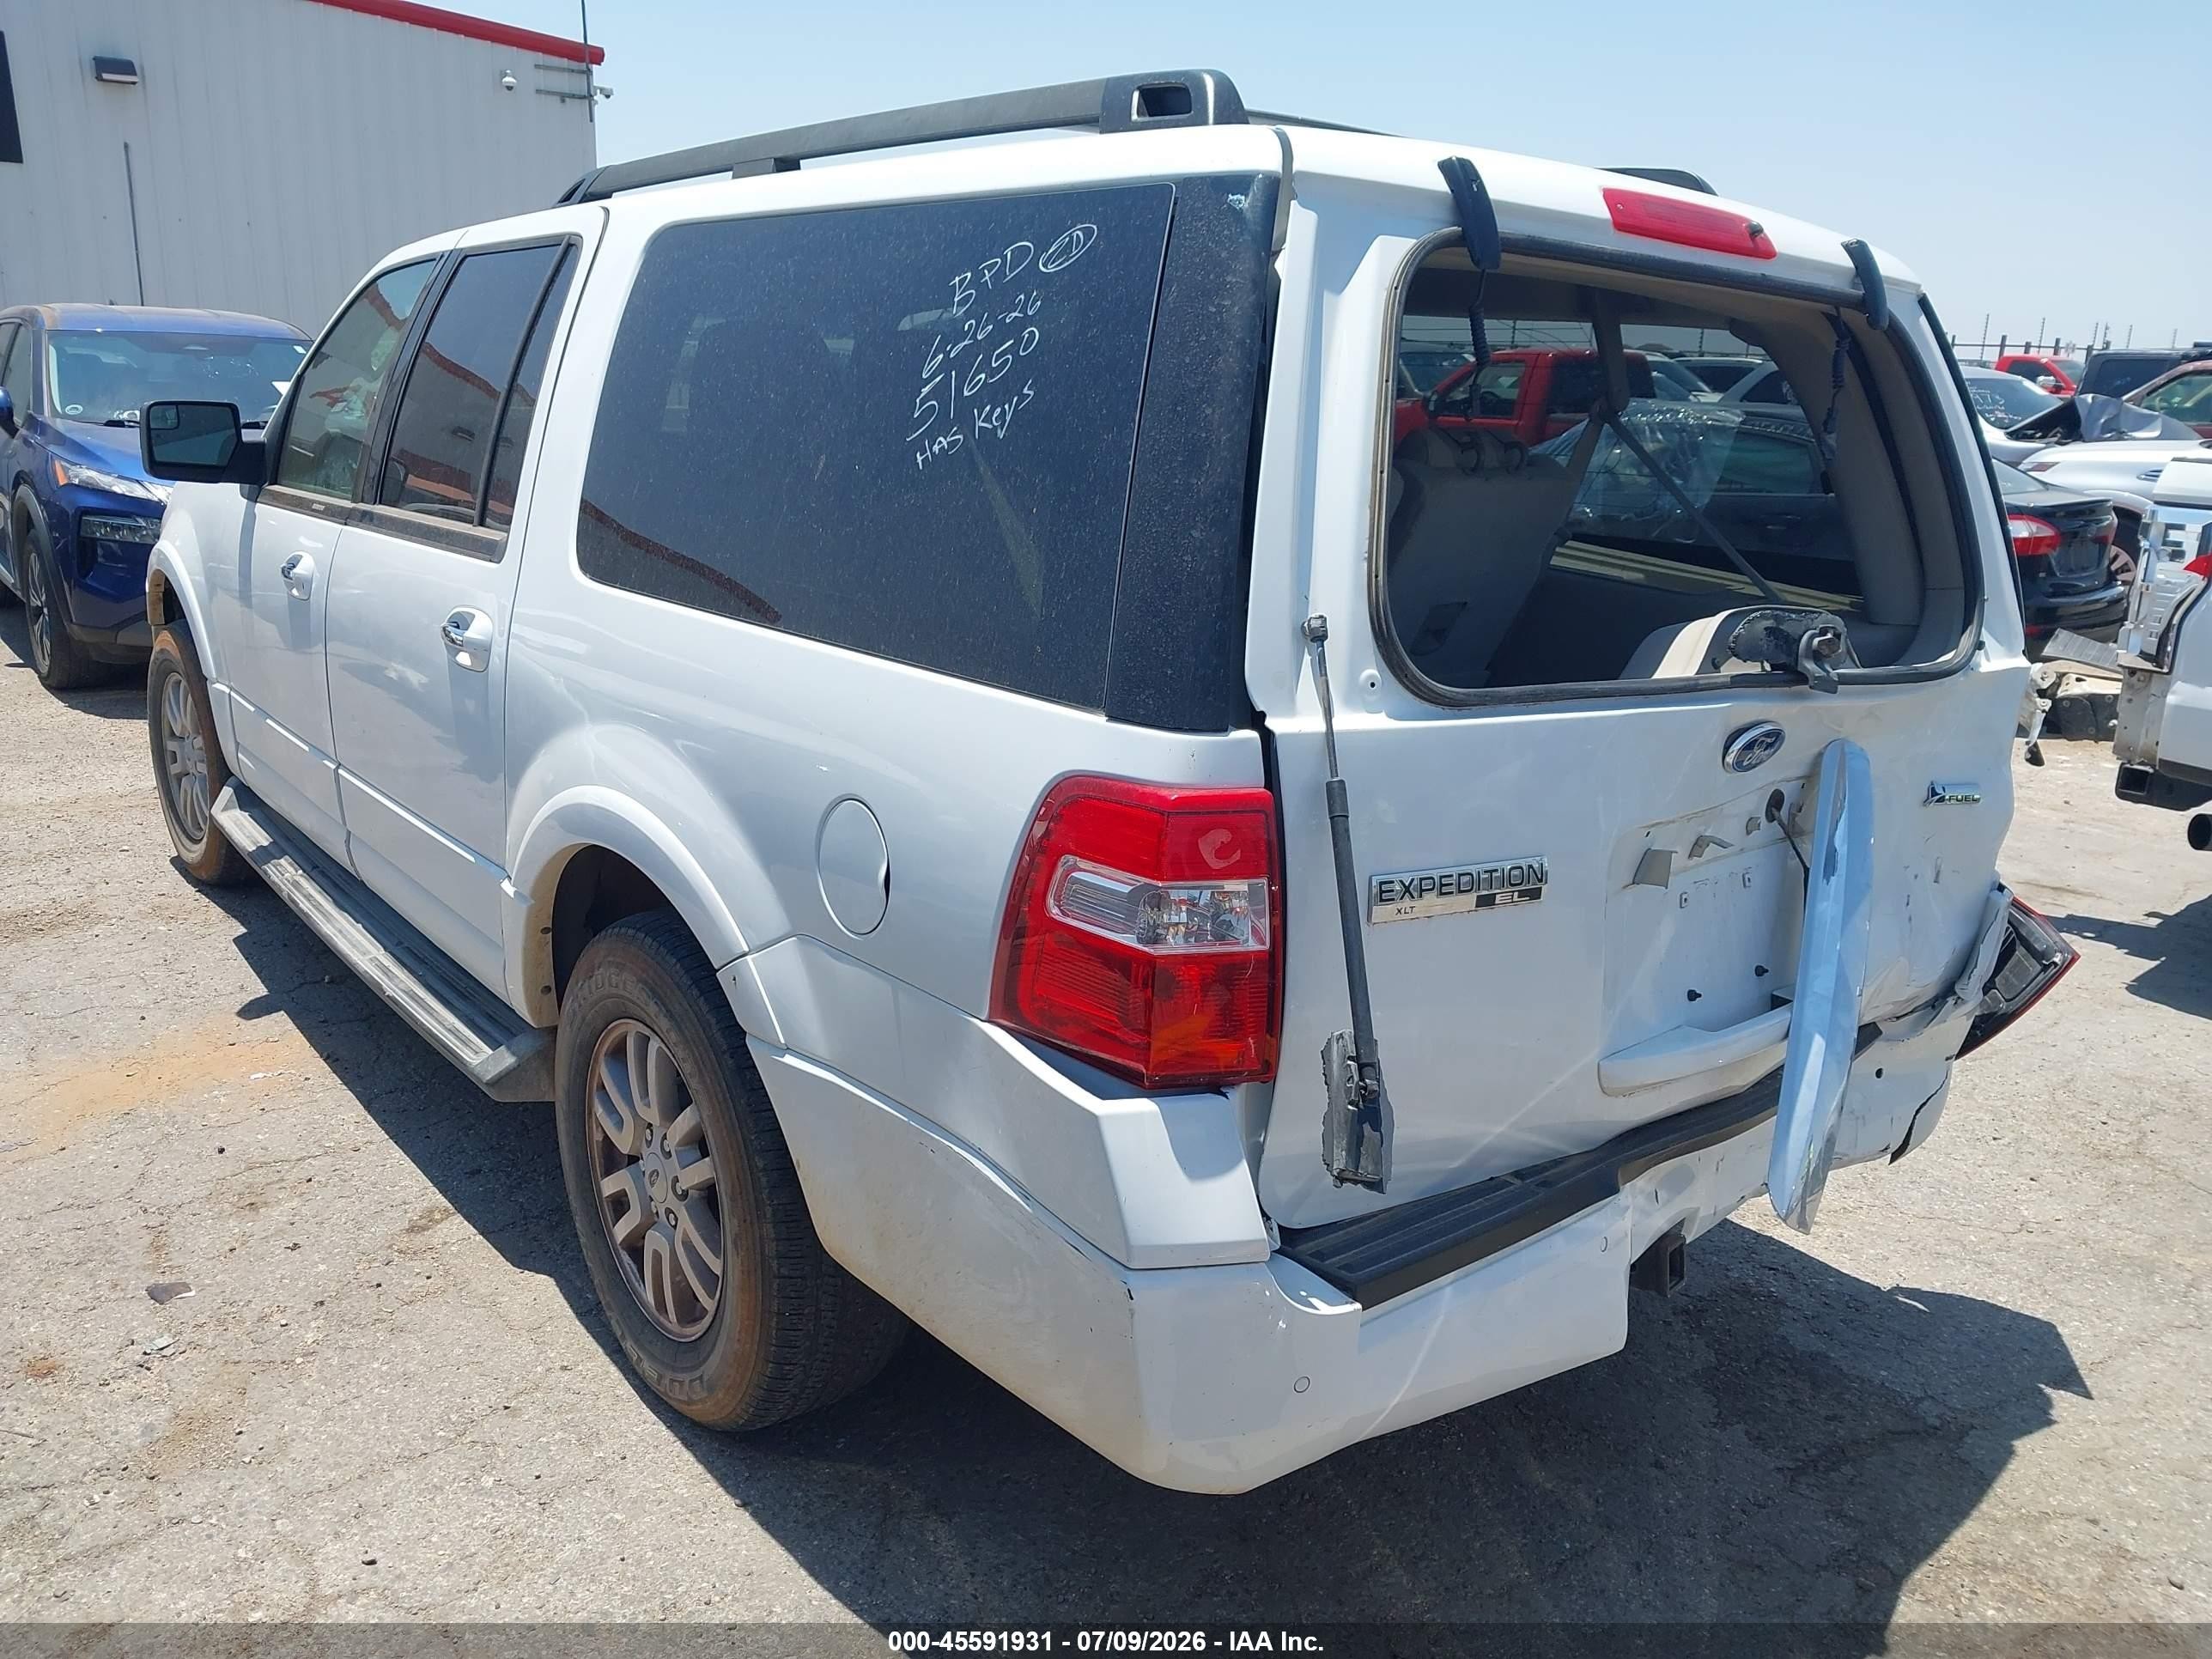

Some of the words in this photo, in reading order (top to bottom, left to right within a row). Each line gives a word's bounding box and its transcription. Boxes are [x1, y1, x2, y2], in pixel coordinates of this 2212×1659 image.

[949, 241, 1034, 317] BPD
[921, 289, 1042, 379] 6-26-26
[915, 426, 963, 470] HAS
[1376, 860, 1545, 903] EXPEDITION
[1494, 890, 1531, 902] EL
[1395, 905, 1416, 915] XLT
